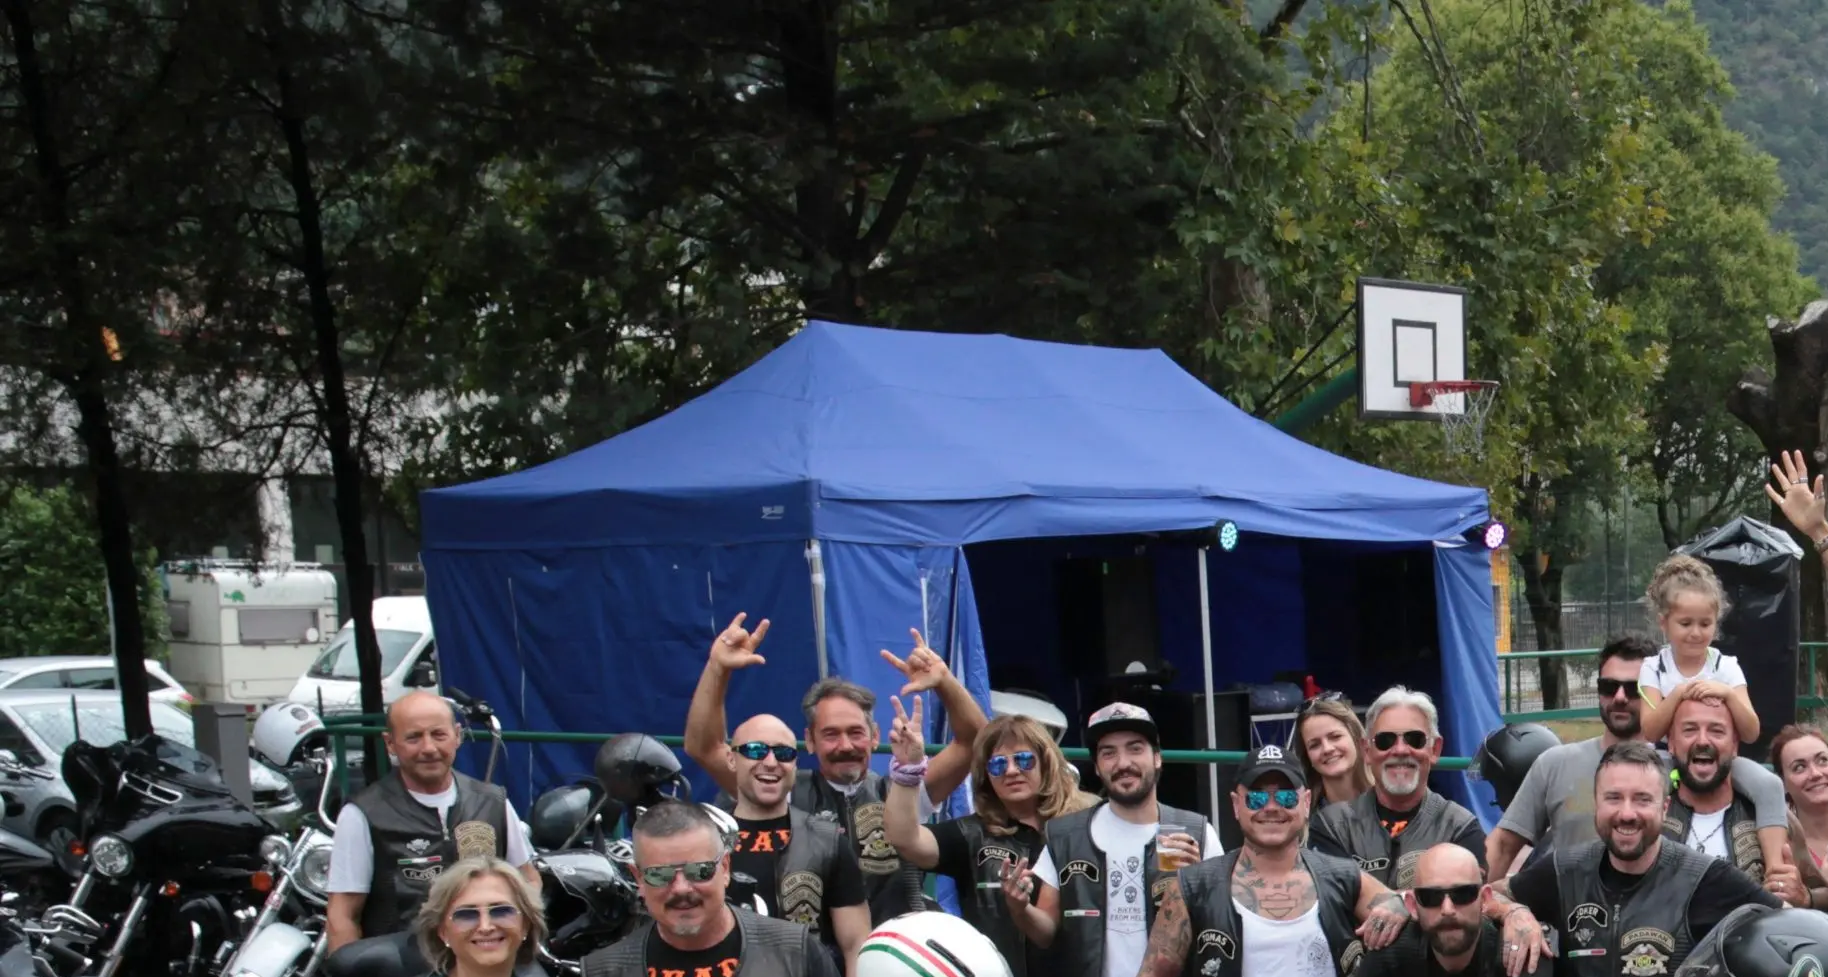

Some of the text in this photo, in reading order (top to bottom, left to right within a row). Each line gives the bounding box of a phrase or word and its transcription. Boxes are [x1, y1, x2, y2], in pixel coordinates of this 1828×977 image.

[1067, 863, 1088, 873] SALE
[1576, 907, 1599, 918] JOKER
[1202, 933, 1228, 945] TOMAS
[1628, 931, 1668, 942] PADAWAN
